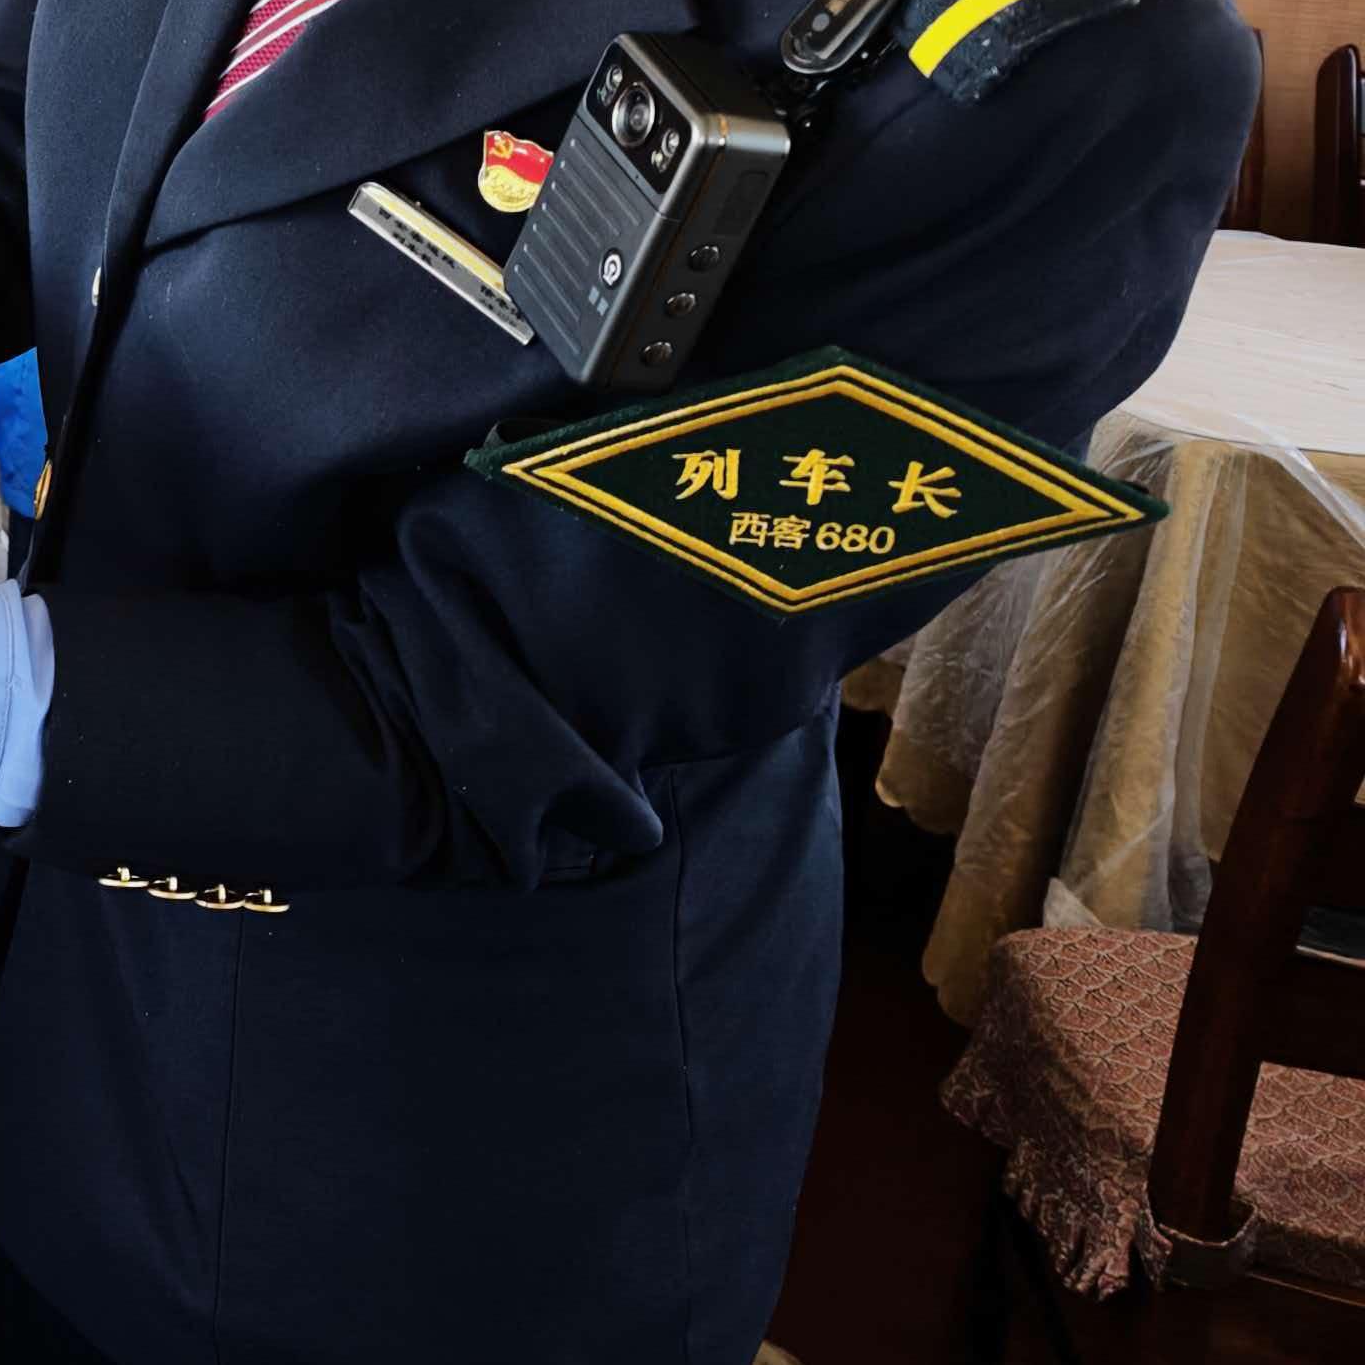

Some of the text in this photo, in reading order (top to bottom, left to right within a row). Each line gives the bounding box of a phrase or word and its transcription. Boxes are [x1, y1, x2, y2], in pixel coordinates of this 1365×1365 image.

[672, 448, 962, 518] 列车长
[729, 511, 896, 554] 西客680
